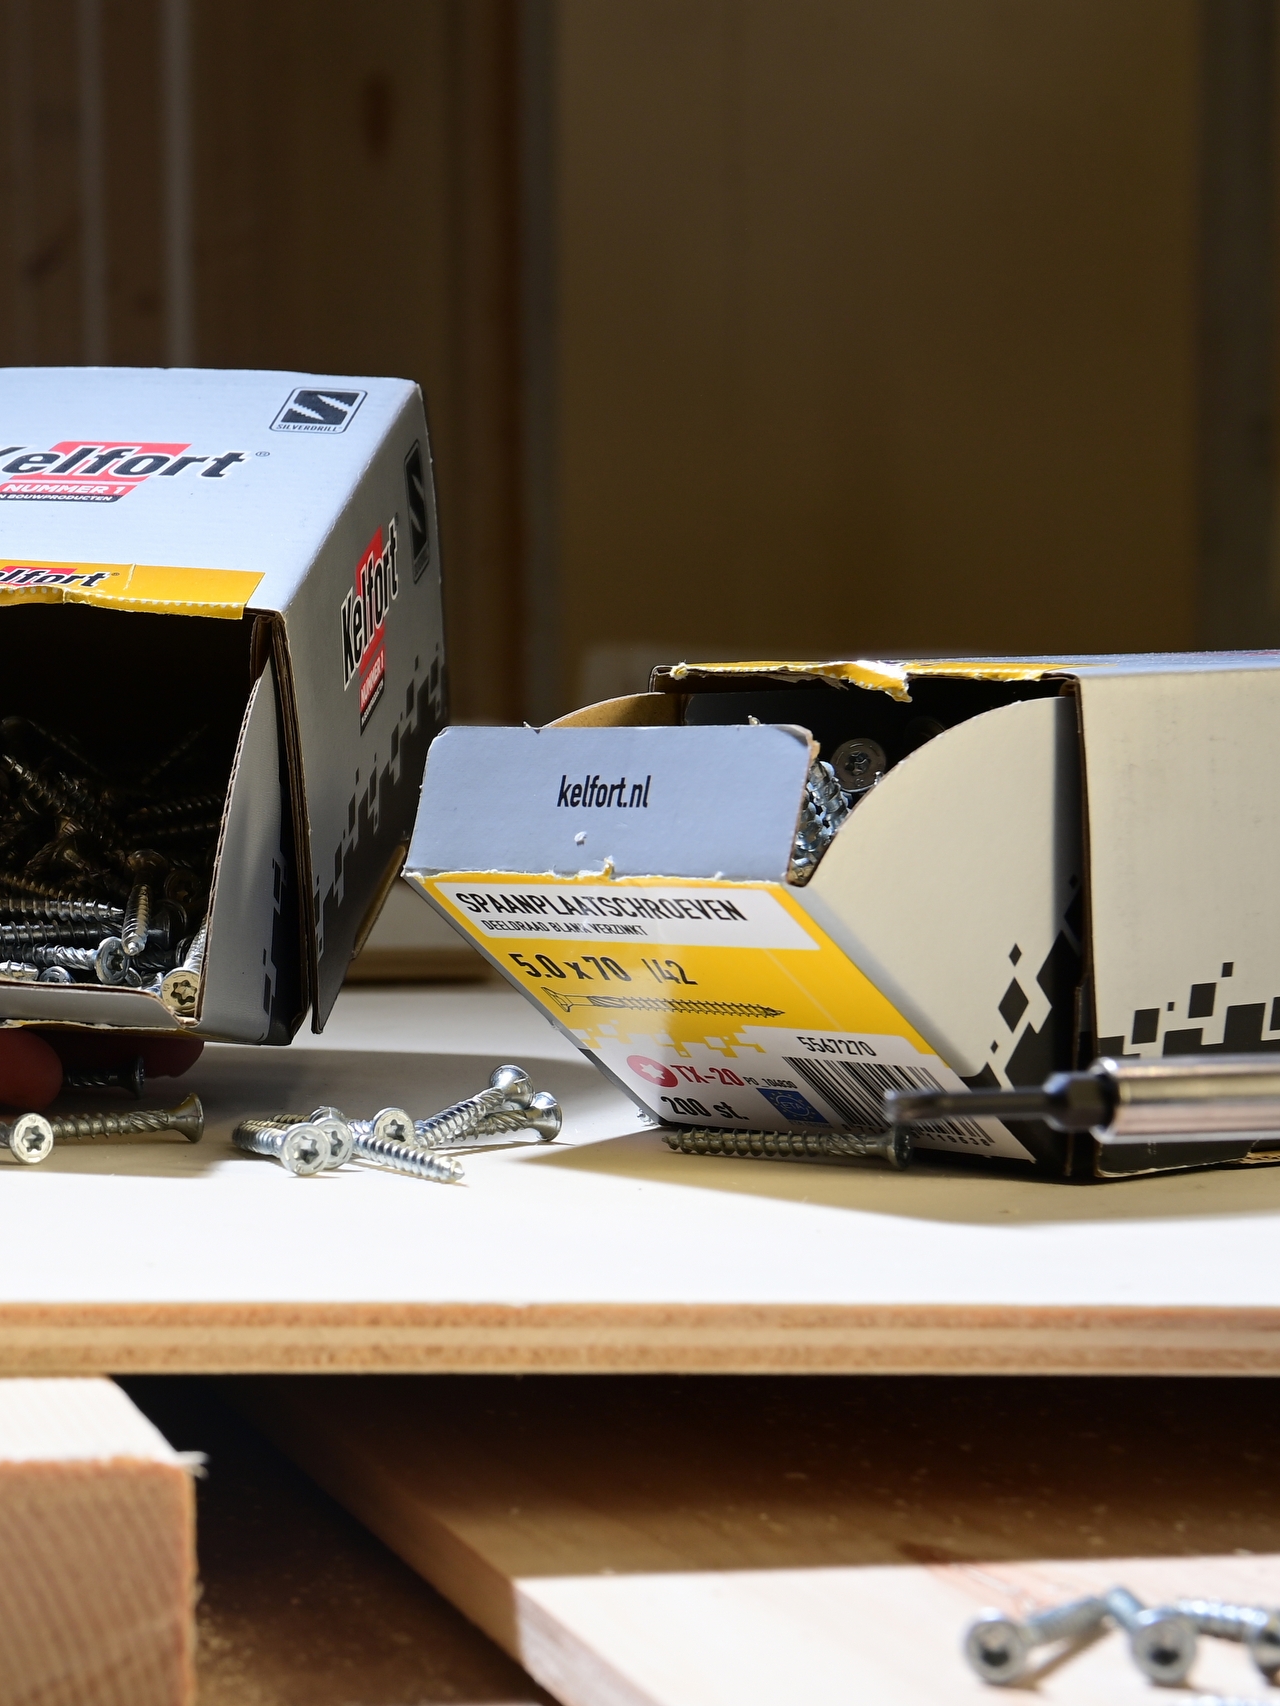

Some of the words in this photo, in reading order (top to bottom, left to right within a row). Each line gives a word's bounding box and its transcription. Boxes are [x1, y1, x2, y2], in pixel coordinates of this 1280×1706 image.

[276, 424, 338, 432] SILVERDRILL
[2, 483, 109, 494] NUMMER
[113, 485, 126, 494] 1
[6, 493, 113, 502] BOUWPRODUCTEN
[341, 517, 398, 690] Kelfort
[557, 774, 652, 808] kelfort.nl
[455, 892, 749, 921] SPAANPLAATSCHROEVEN
[480, 919, 551, 932] DEELDRAAD
[549, 922, 591, 934] BLANK
[589, 923, 649, 936] VERZINKT
[508, 953, 567, 979] 5.0
[562, 962, 595, 980] x
[580, 956, 632, 982] 70
[796, 1036, 877, 1057] 5567270
[669, 1064, 745, 1087] TX-20
[660, 1095, 712, 1117] 200
[712, 1101, 750, 1120] st.
